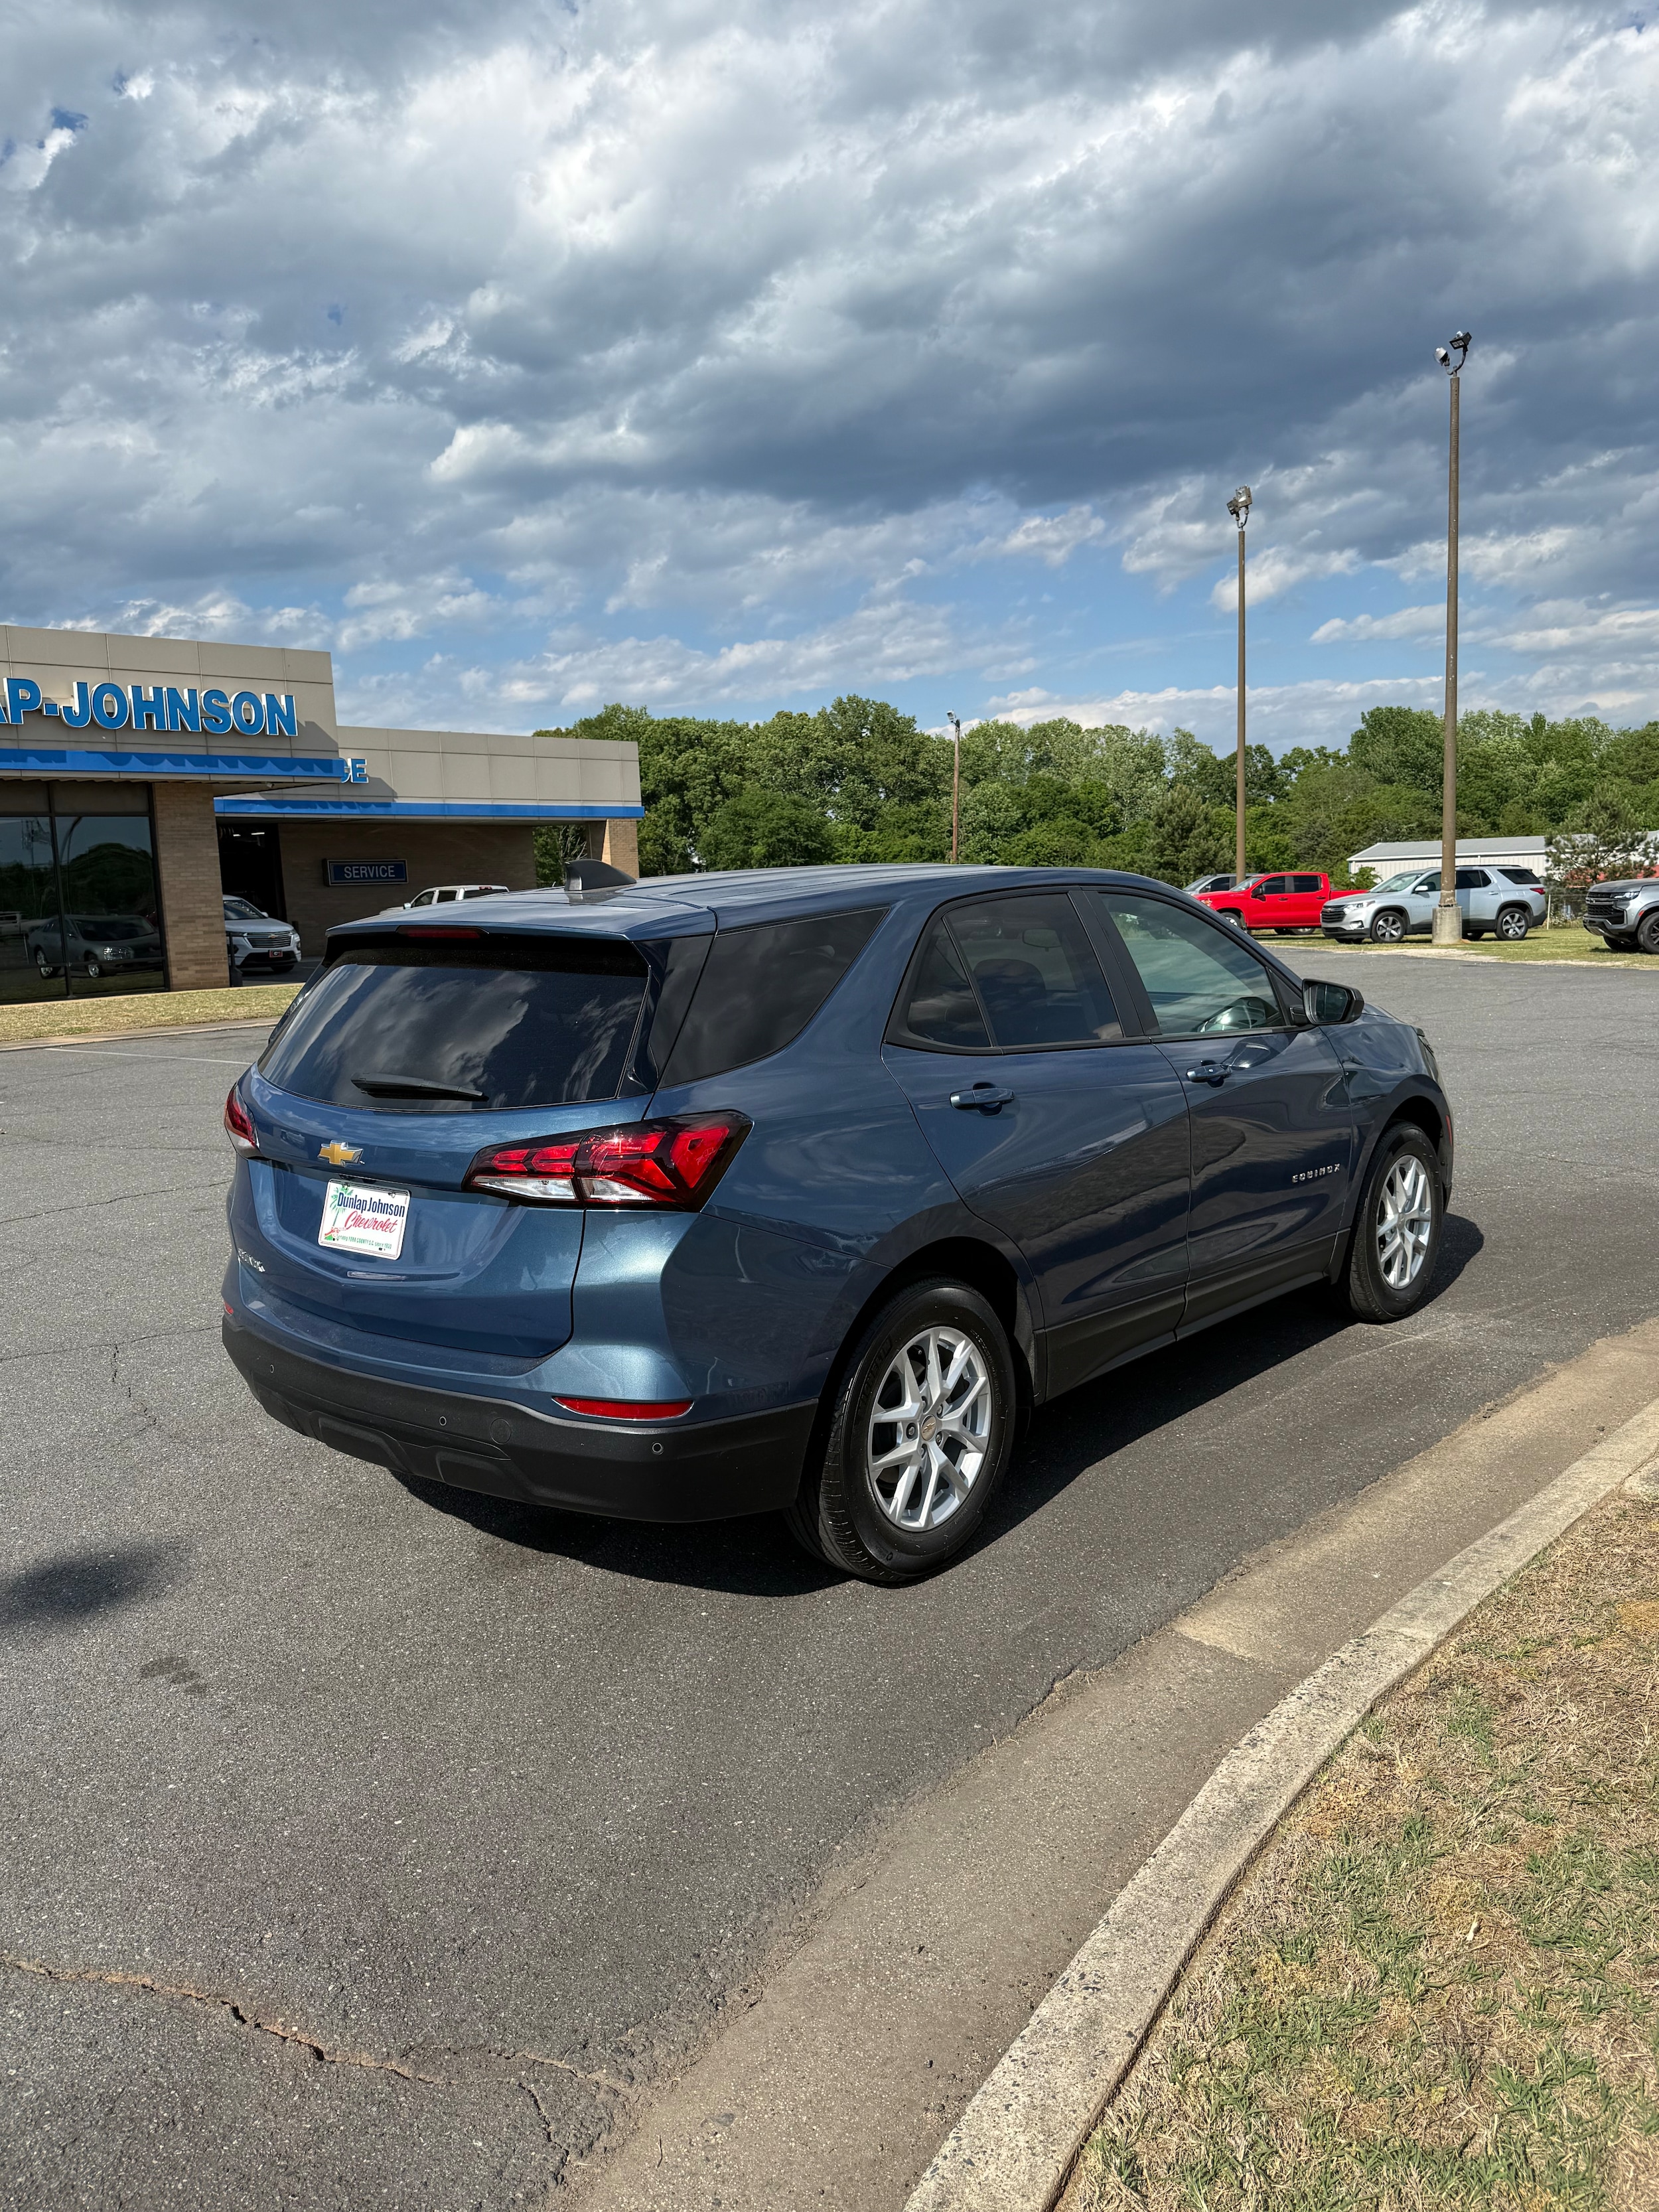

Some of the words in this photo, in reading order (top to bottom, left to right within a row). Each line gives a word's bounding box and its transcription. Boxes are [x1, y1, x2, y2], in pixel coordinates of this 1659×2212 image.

[344, 865, 396, 879] SERVICE
[1291, 1163, 1340, 1183] EQUINOX
[344, 1210, 398, 1233] Chevrolet
